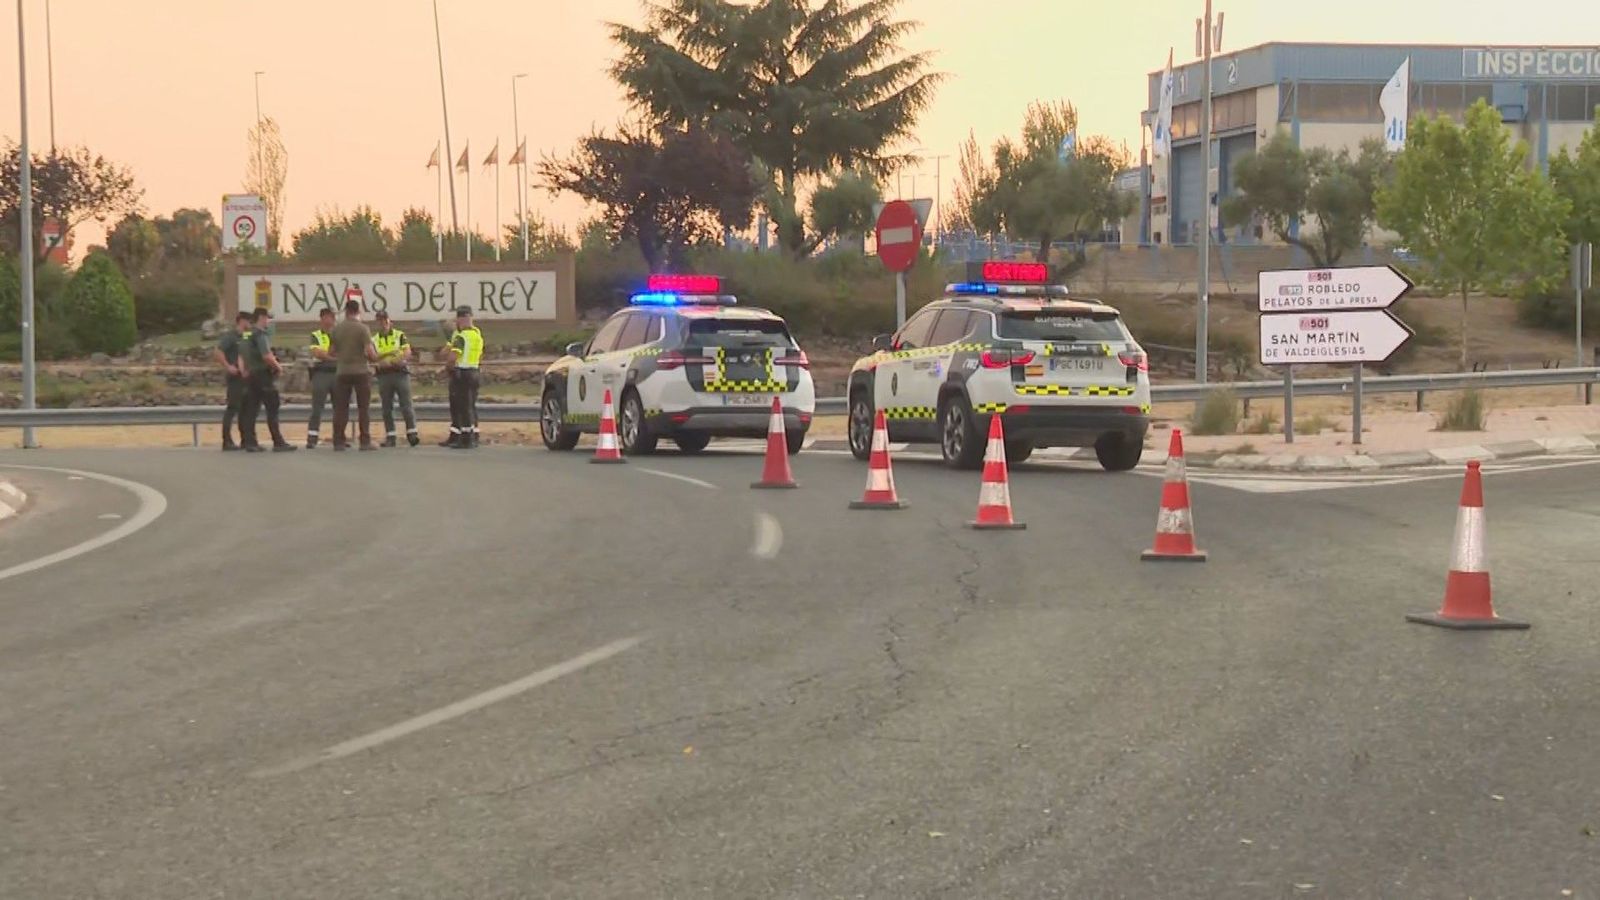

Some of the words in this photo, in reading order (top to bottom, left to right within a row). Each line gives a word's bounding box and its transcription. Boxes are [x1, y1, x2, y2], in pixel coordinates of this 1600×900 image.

[1228, 61, 1237, 84] 2
[1308, 283, 1360, 293] ROBLEDO
[282, 277, 388, 313] NAVAS
[403, 280, 458, 312] DEL
[478, 276, 538, 314] REY
[1264, 297, 1313, 307] PELAYOS
[1320, 296, 1330, 305] DE
[1335, 296, 1345, 305] LA
[1350, 296, 1378, 304] PRESA
[1271, 334, 1298, 345] SAN
[1307, 331, 1360, 344] MARTÍN
[1265, 348, 1278, 358] DE
[1285, 346, 1366, 357] VALDEIGLESIAS
